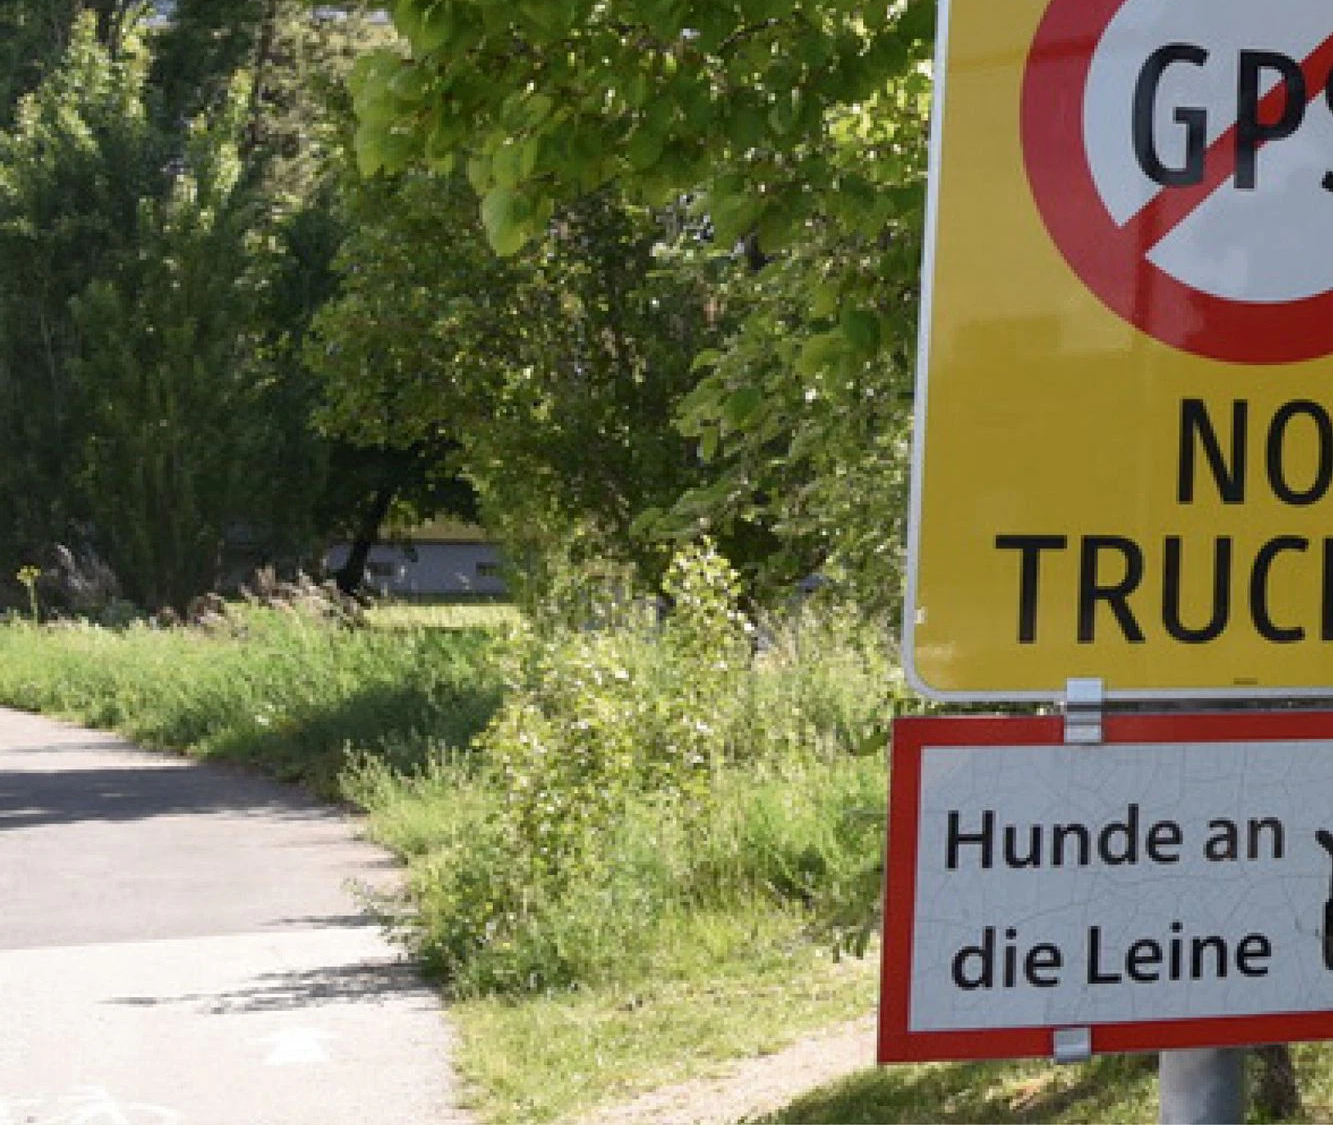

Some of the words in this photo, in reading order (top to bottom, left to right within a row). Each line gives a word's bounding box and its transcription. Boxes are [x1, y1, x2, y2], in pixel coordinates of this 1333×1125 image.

[946, 803, 1184, 870] Hunde
[1205, 816, 1285, 862] an
[951, 925, 1062, 991] die
[1087, 921, 1272, 985] Leine
